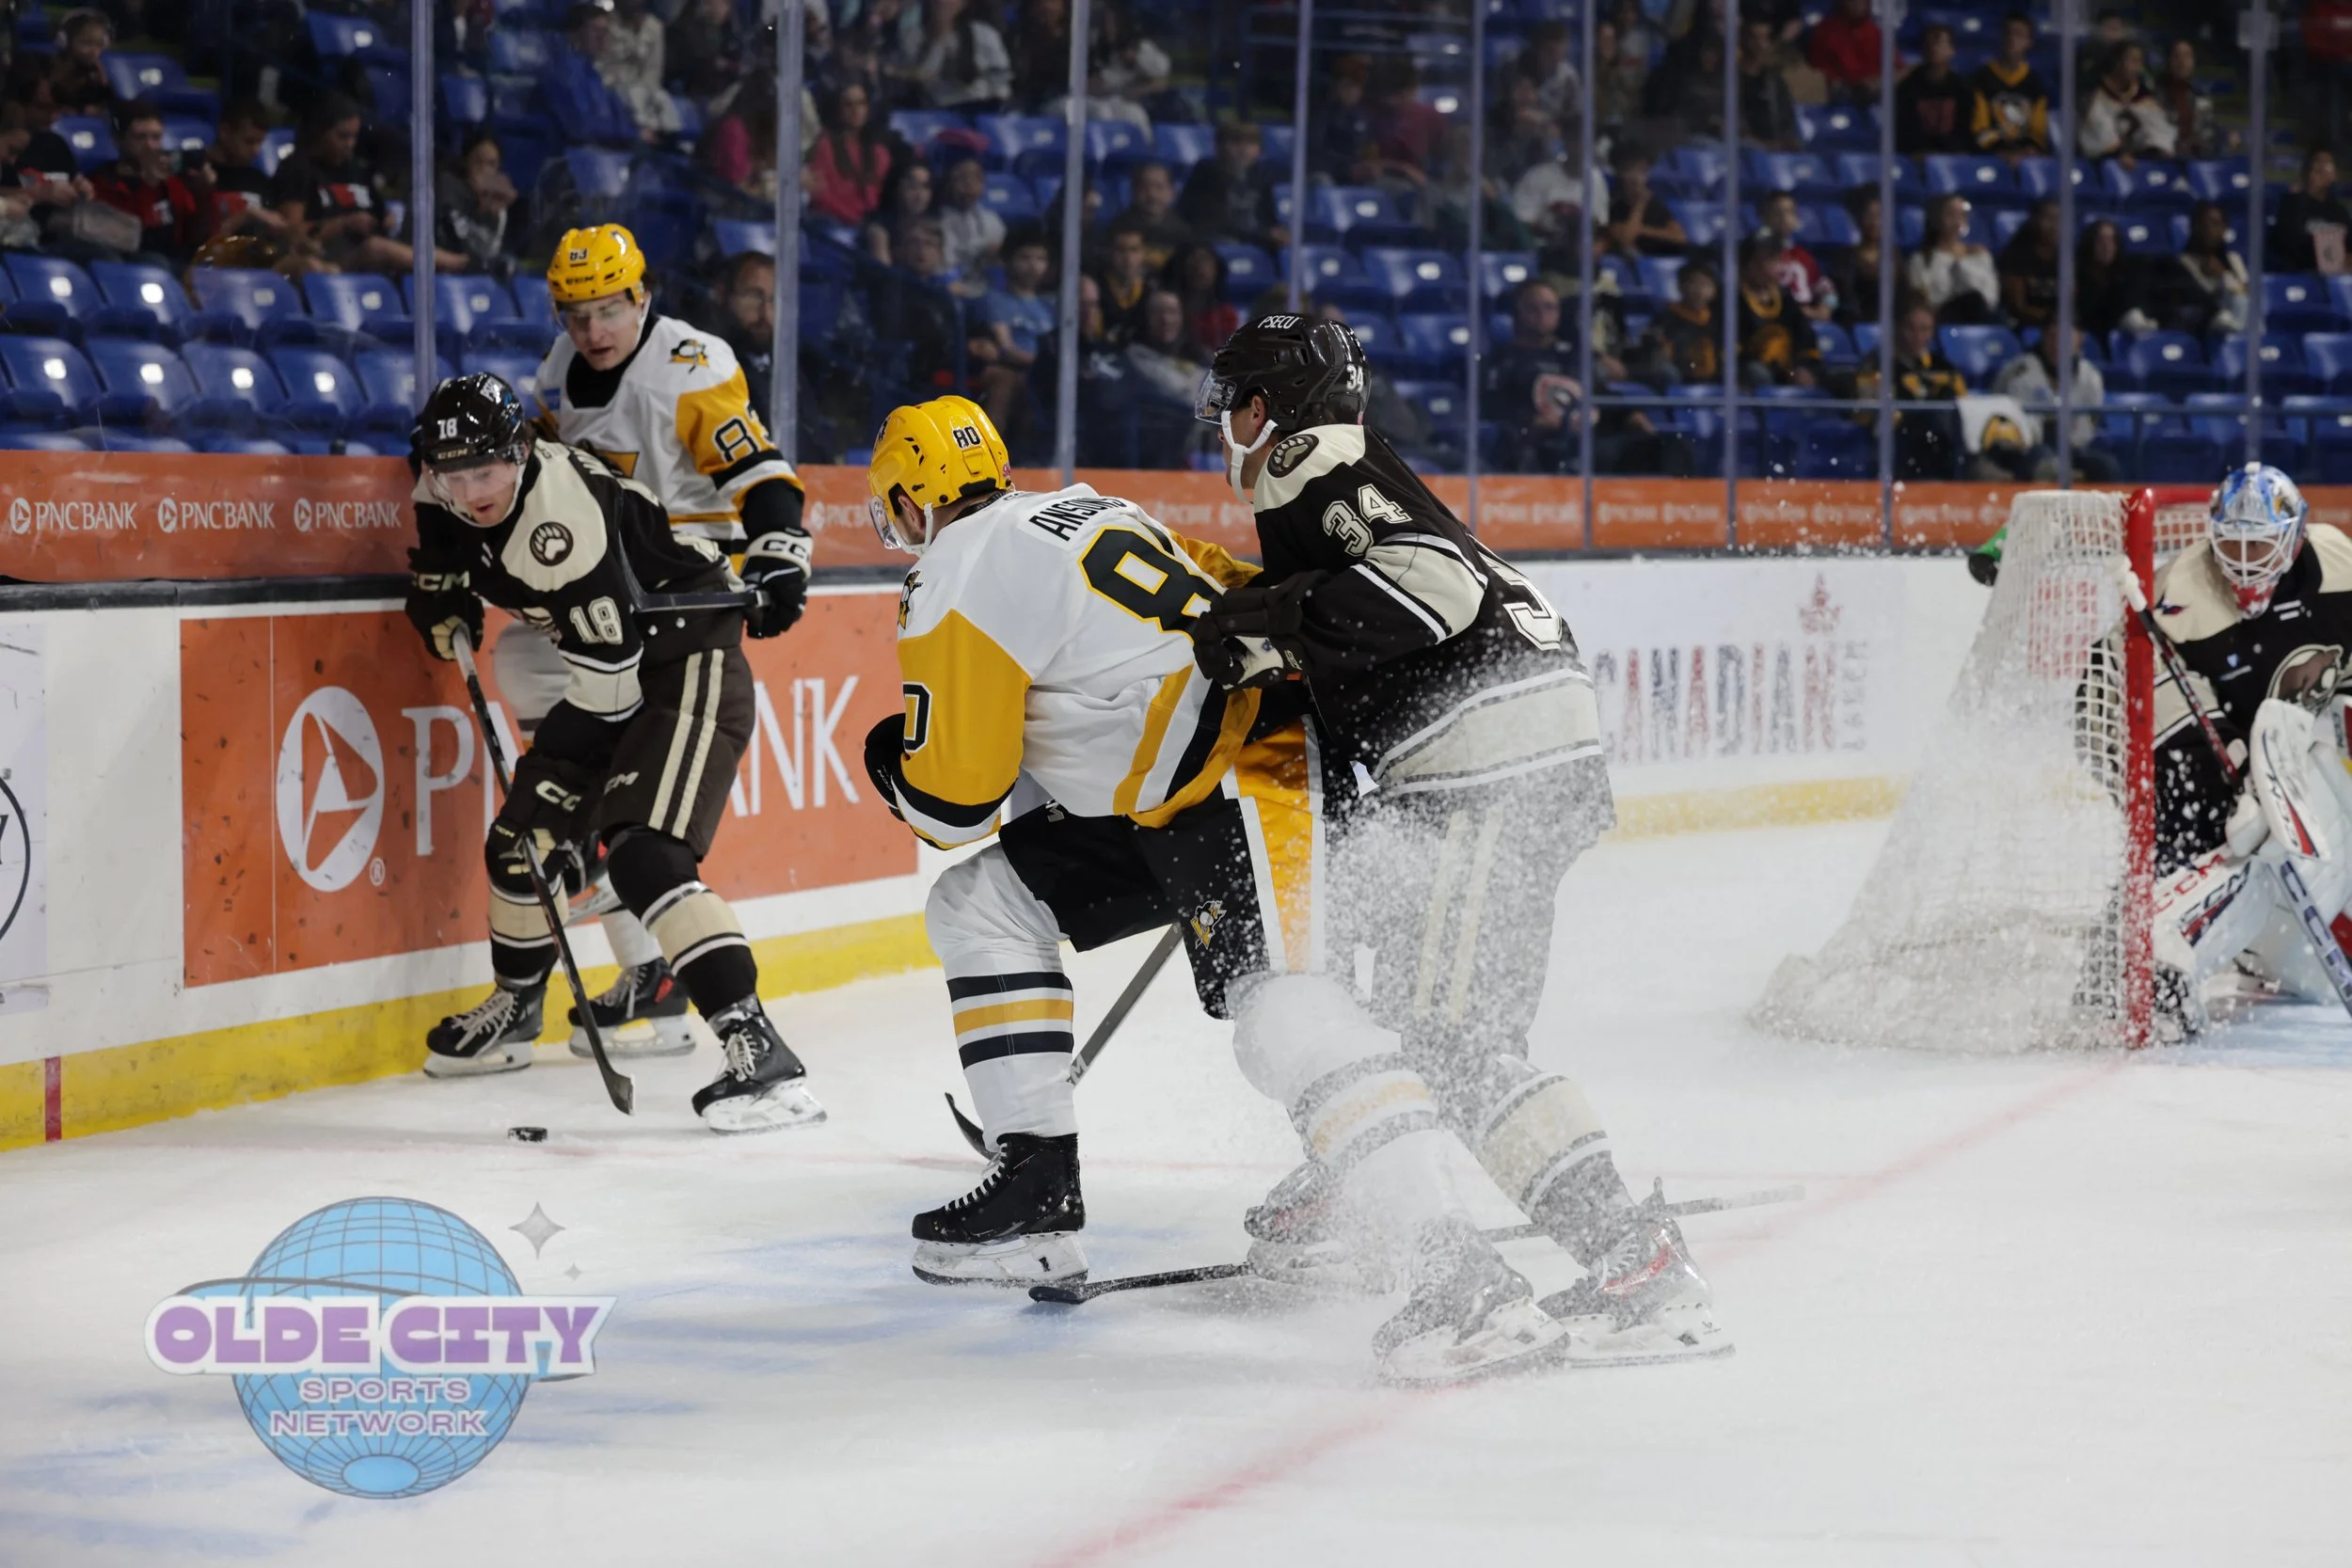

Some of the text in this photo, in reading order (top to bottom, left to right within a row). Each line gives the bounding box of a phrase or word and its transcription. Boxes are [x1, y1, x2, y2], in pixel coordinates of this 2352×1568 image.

[1258, 315, 1299, 329] PSECU
[1346, 364, 1363, 392] 34
[437, 418, 458, 440] 18
[952, 426, 981, 449] 80
[437, 448, 468, 460] CCM
[1323, 483, 1412, 557] 34
[762, 539, 809, 562] CC
[411, 570, 469, 592] CM
[569, 595, 623, 645] 18
